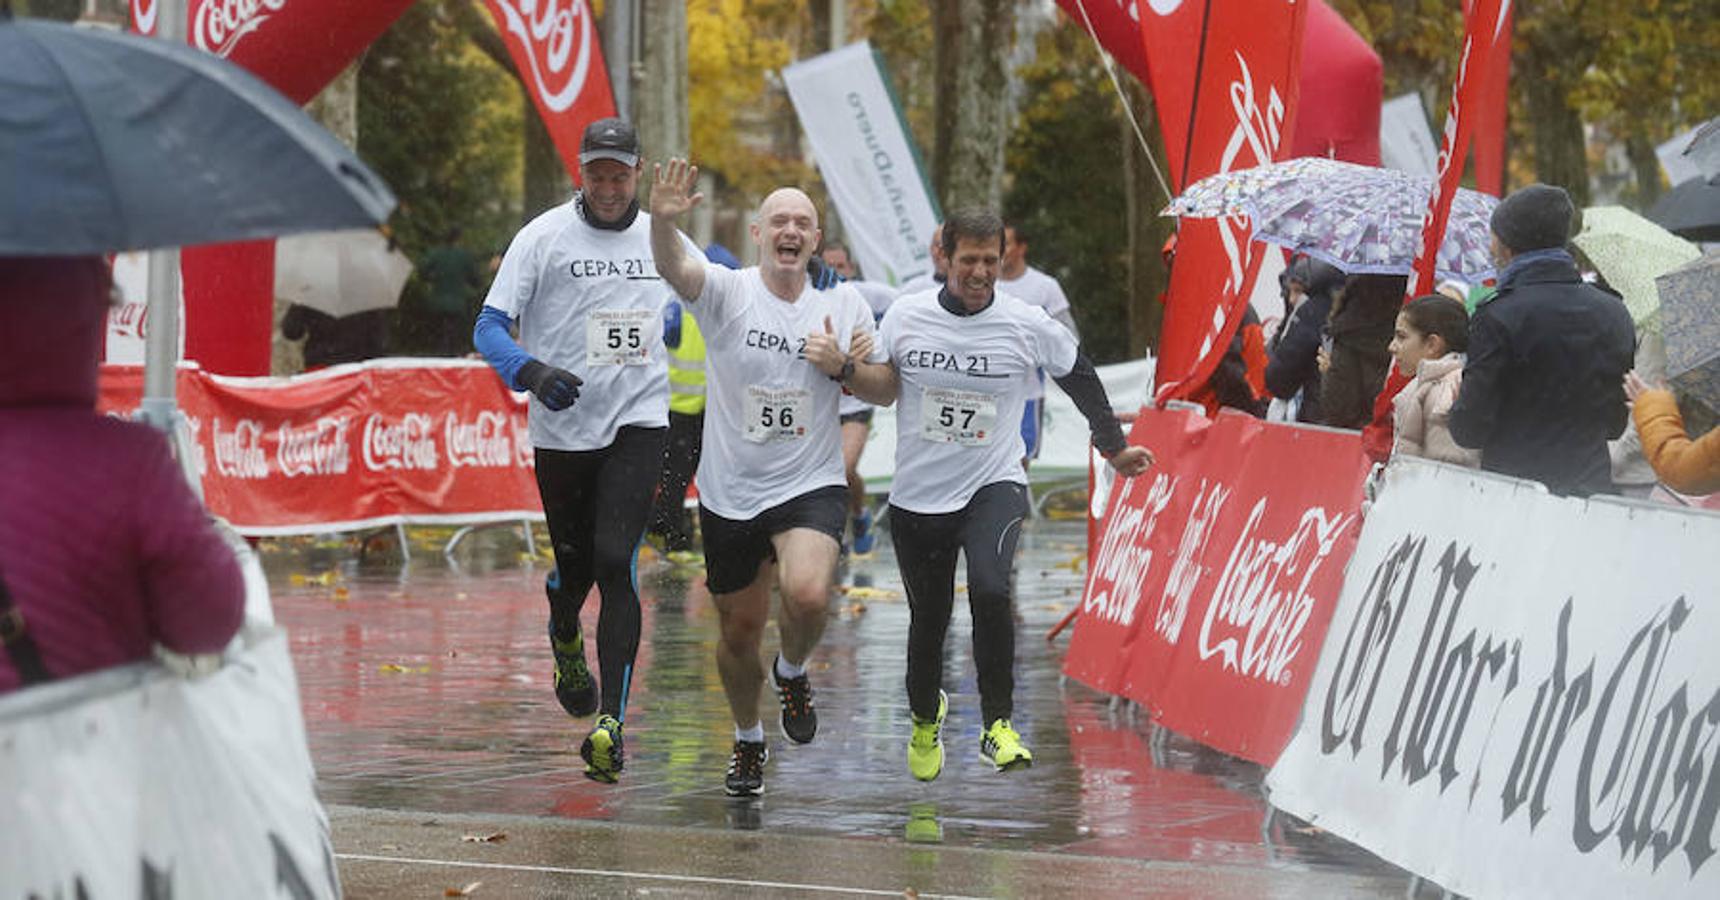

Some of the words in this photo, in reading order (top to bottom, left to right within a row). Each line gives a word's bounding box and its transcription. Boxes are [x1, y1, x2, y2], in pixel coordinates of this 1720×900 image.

[570, 259, 620, 278] CEPA
[624, 259, 643, 275] 21
[607, 327, 641, 349] 55
[746, 329, 791, 355] CEPA
[796, 337, 808, 354] 2
[906, 349, 959, 371] CEPA
[966, 355, 989, 373] 21
[761, 406, 794, 427] 56
[939, 405, 976, 430] 57
